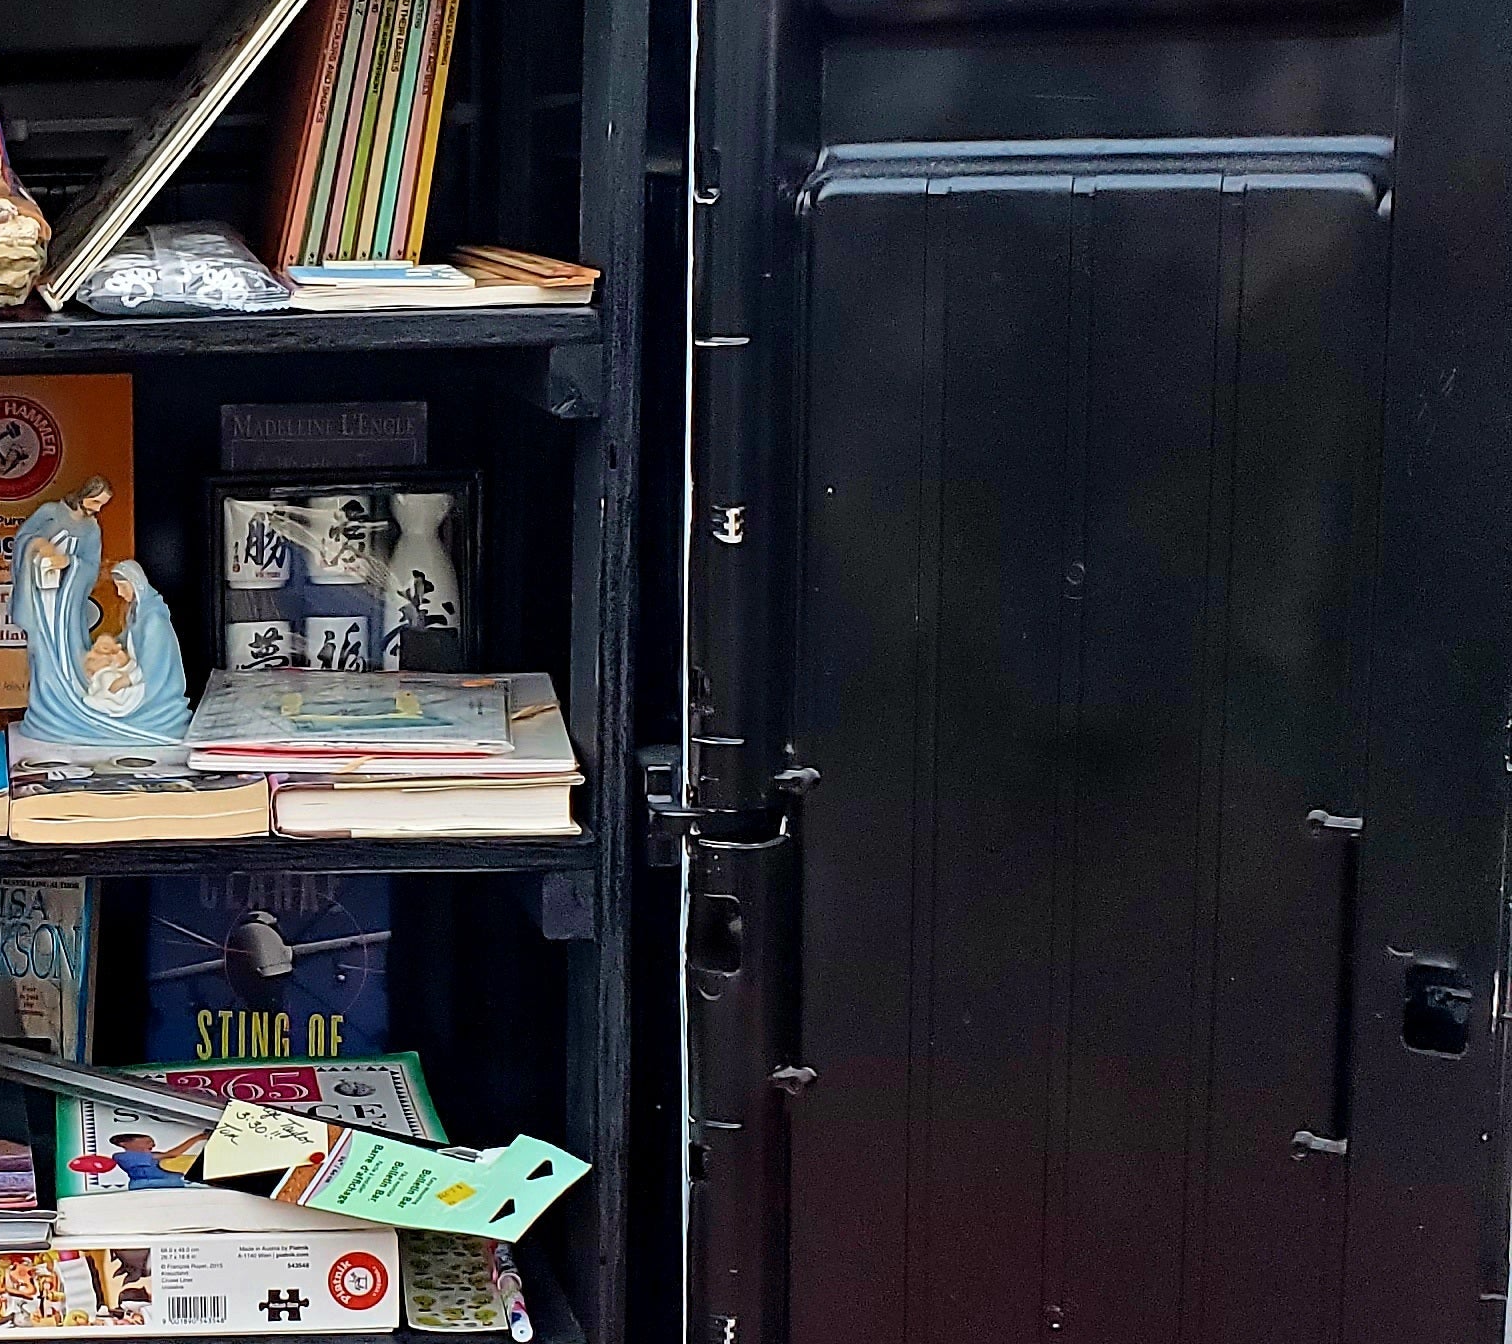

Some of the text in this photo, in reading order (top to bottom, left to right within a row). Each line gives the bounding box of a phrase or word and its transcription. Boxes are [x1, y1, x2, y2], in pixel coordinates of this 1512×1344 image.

[4, 401, 56, 456] HAMMER
[197, 1010, 344, 1061] STING OF
[178, 1071, 309, 1101] 365
[365, 1144, 384, 1164] Barre
[397, 1169, 432, 1209] Bulletin Bar
